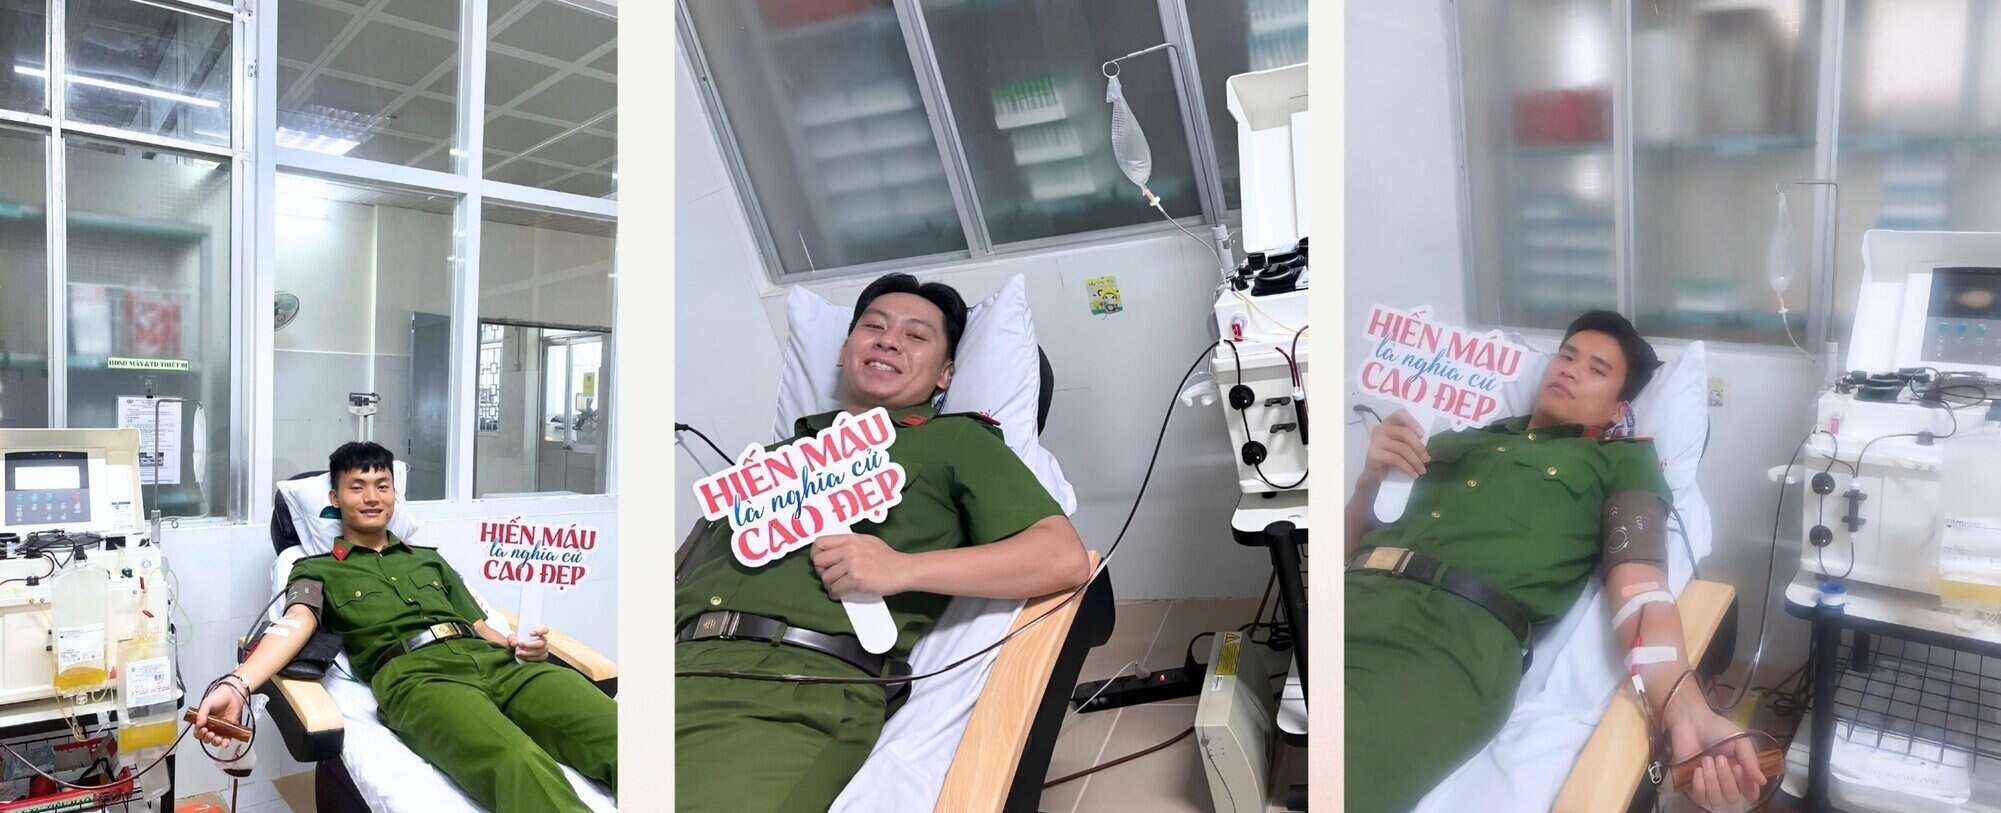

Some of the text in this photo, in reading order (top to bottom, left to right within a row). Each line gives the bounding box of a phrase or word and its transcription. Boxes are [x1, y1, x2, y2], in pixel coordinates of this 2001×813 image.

[1367, 308, 1522, 376] HIẾN MÁU
[1361, 361, 1497, 426] CAO ĐẸP
[700, 413, 889, 515] HIẾN MÁU
[734, 492, 765, 527] là
[771, 465, 846, 520] nghĩa
[480, 516, 597, 550] HIẾN MÁU
[737, 468, 900, 561] CAO ĐẸP
[483, 559, 586, 591] CAO ĐẸP
